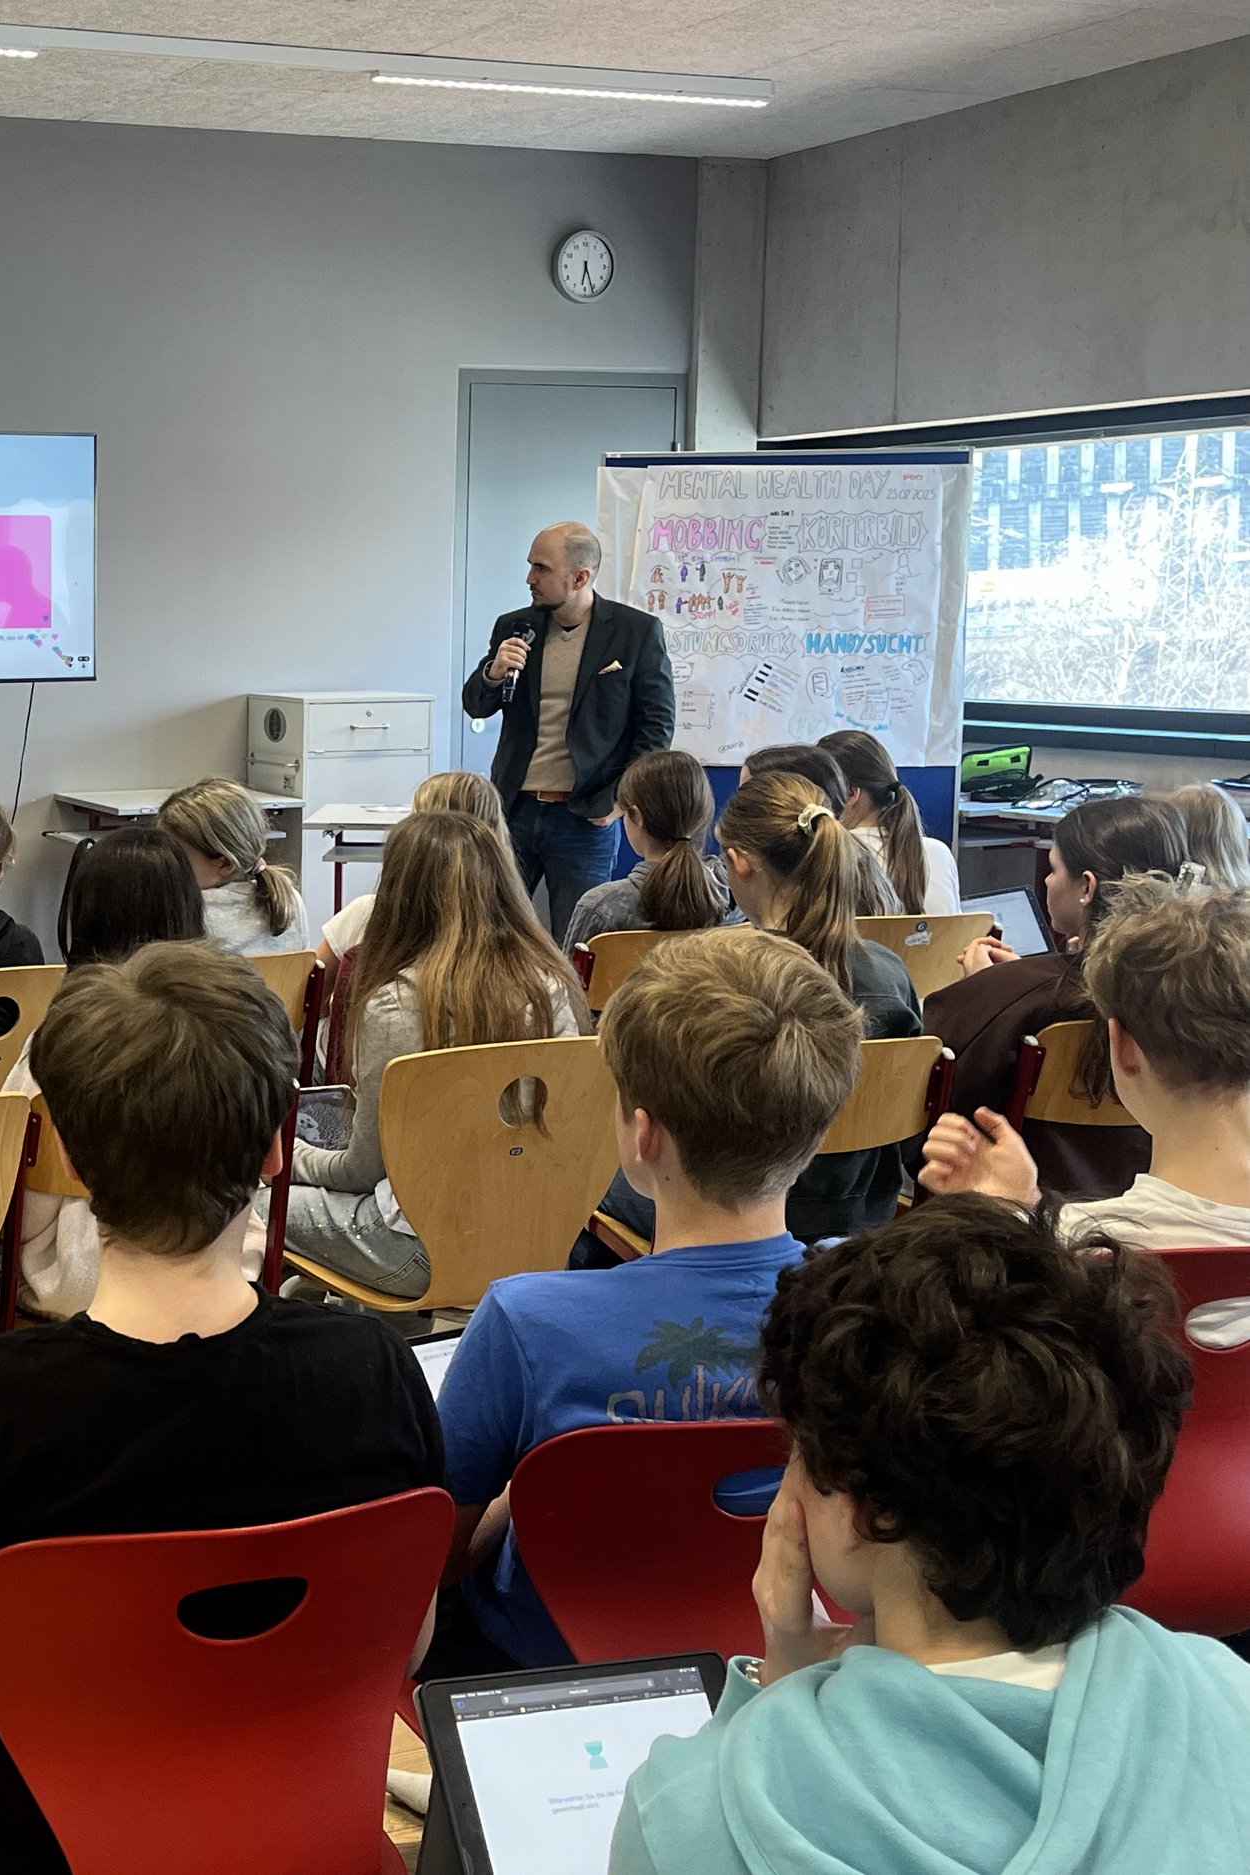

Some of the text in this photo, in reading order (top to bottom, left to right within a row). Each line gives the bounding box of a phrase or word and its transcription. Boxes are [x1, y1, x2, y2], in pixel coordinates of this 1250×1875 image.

[659, 470, 891, 500] MENTAL HEALTH DAY
[802, 515, 921, 550] KÖRPERBILD
[675, 555, 685, 563] IST
[665, 630, 792, 655] ISTUNGSDRUCK
[805, 632, 924, 655] HANDYSUCHT
